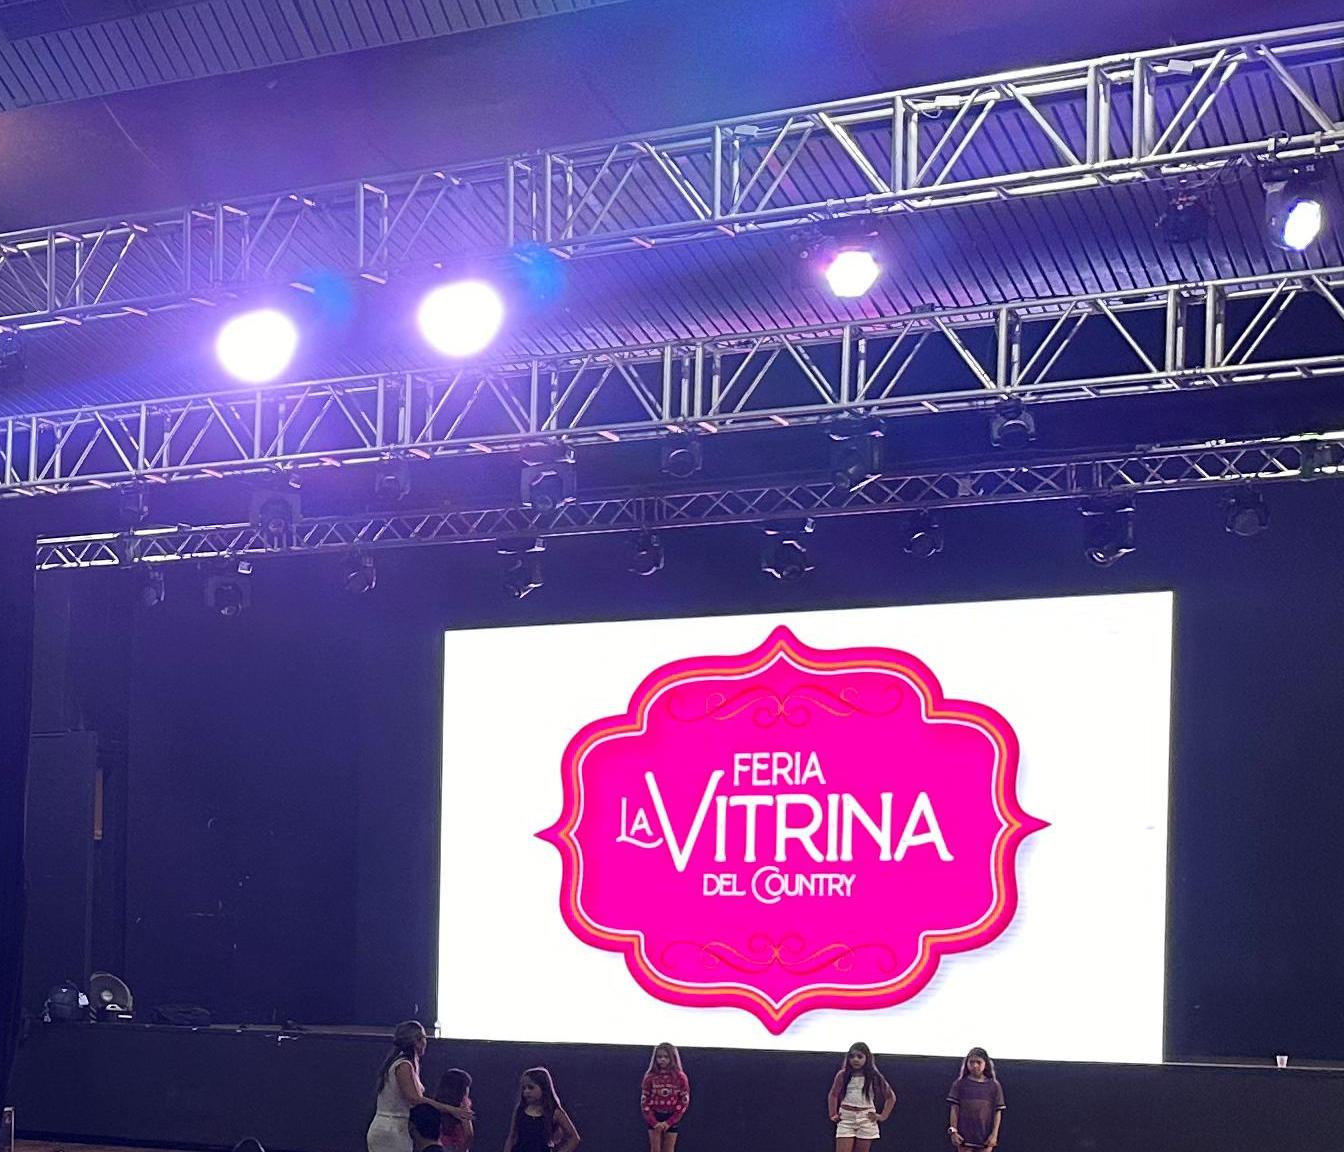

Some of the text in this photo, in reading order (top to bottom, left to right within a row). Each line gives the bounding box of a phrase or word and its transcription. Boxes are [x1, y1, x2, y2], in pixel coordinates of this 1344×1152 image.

[733, 751, 826, 787] FERIA
[616, 769, 955, 873] LA VITRINA
[702, 865, 857, 905] DEL COUNTRY
